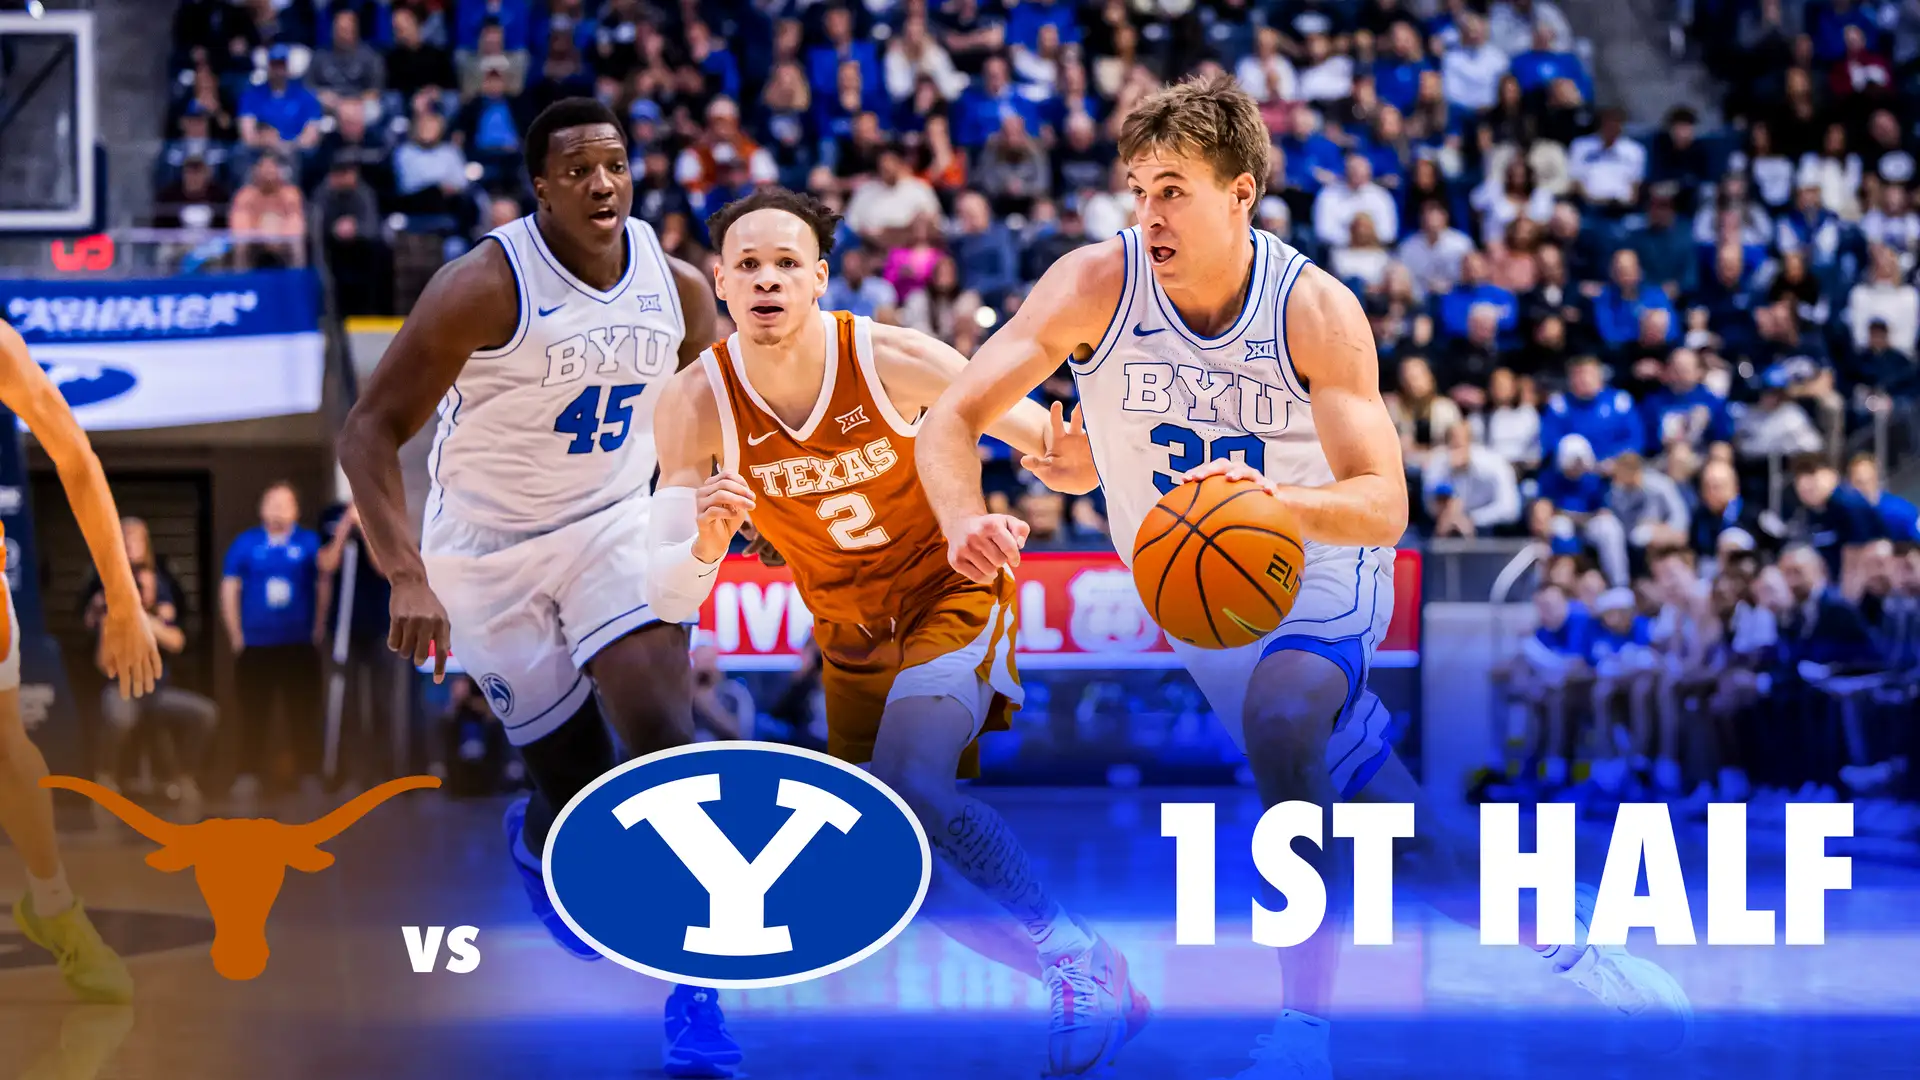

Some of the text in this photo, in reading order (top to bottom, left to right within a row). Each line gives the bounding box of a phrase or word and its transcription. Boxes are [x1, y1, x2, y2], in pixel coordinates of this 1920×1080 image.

[542, 325, 670, 387] BYU
[554, 383, 647, 454] 45
[1123, 362, 1292, 434] BYU
[749, 437, 898, 497] TEXAS
[816, 492, 891, 549] 2
[1265, 553, 1302, 593] ELI
